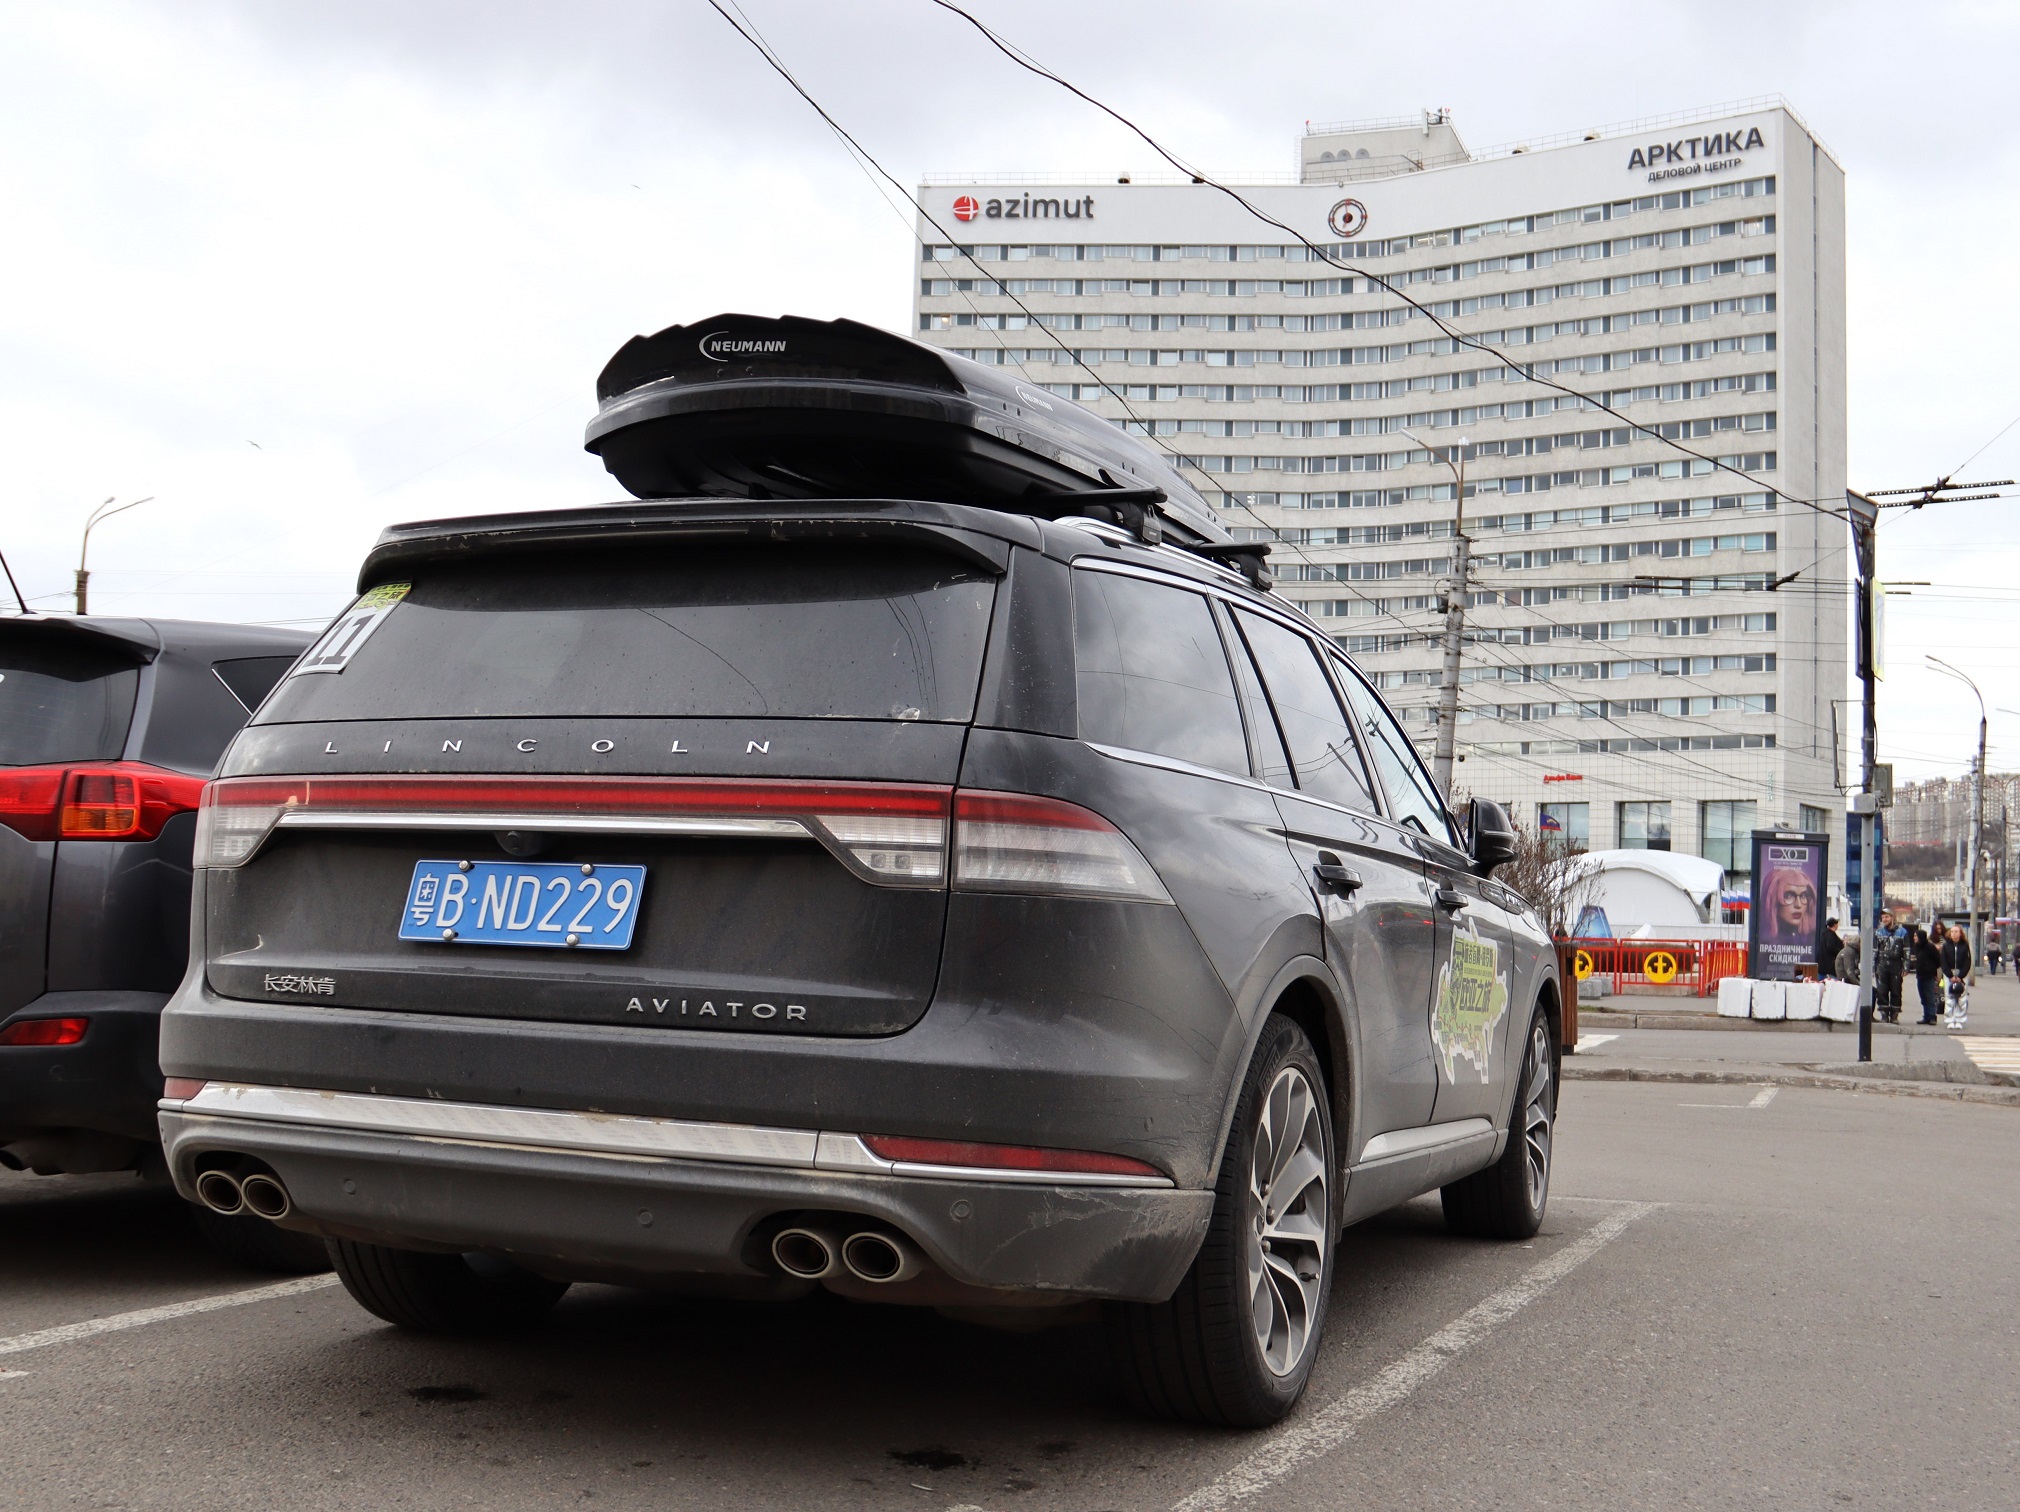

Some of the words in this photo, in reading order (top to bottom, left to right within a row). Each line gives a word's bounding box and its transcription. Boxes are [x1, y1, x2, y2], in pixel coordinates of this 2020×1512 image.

[1627, 127, 1765, 170] АРКТИКА
[1648, 163, 1701, 182] ДЕЛОВОЙ
[1704, 158, 1742, 173] ЦЕНТР
[985, 192, 1094, 218] azimut
[711, 340, 786, 352] NEUMANN
[303, 614, 376, 668] 11
[324, 738, 770, 755] LINCOLN
[1760, 944, 1813, 954] ПРАЗДНИЧНЫЕ
[264, 974, 336, 995] 长安林肯
[626, 997, 807, 1020] AVIATOR
